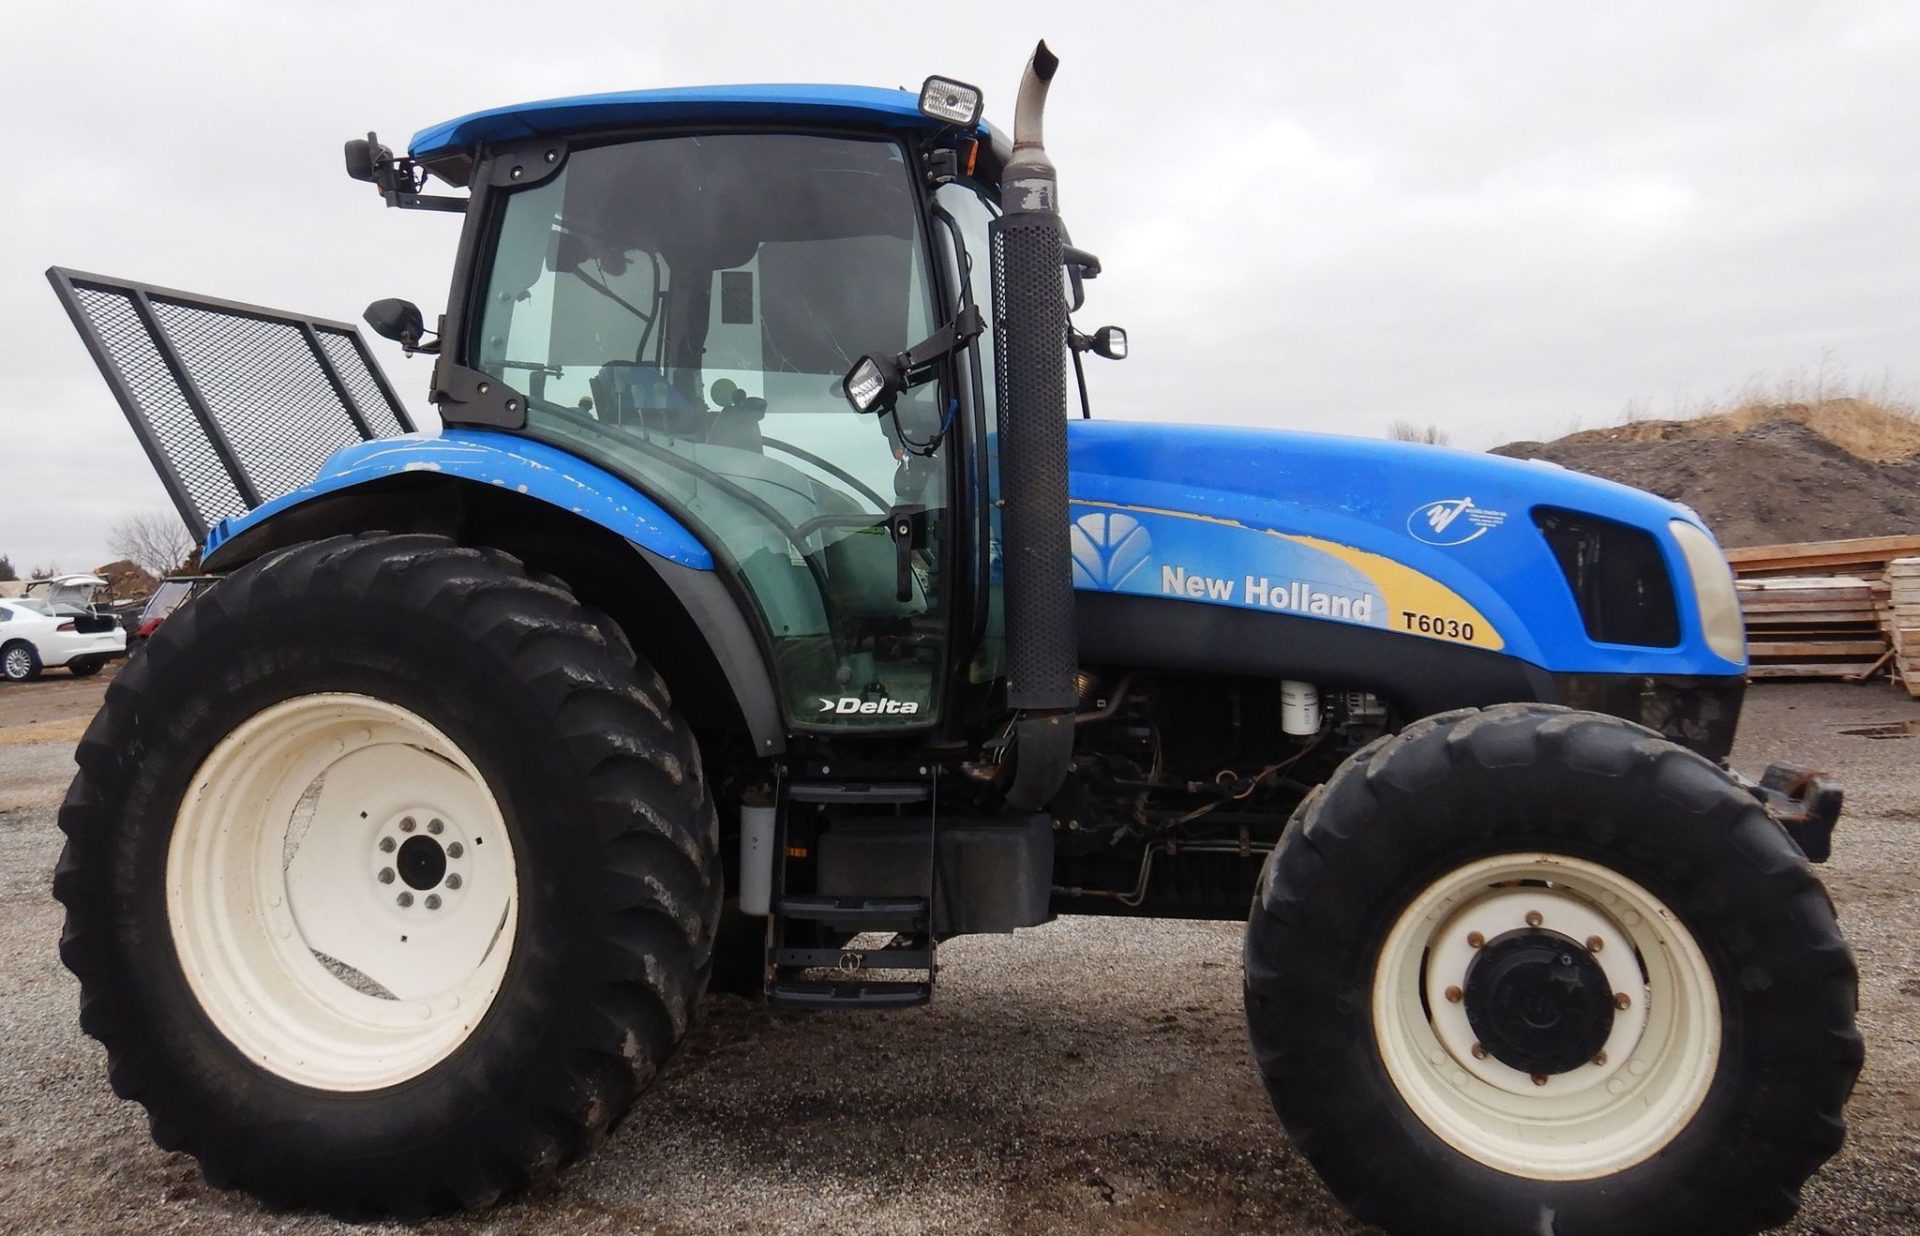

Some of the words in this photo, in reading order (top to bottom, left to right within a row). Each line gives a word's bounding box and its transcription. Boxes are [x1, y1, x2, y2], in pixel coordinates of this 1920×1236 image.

[1161, 565, 1235, 601] New
[1245, 575, 1373, 622] Holland
[1402, 611, 1474, 641] T6030
[835, 697, 919, 714] Delta
